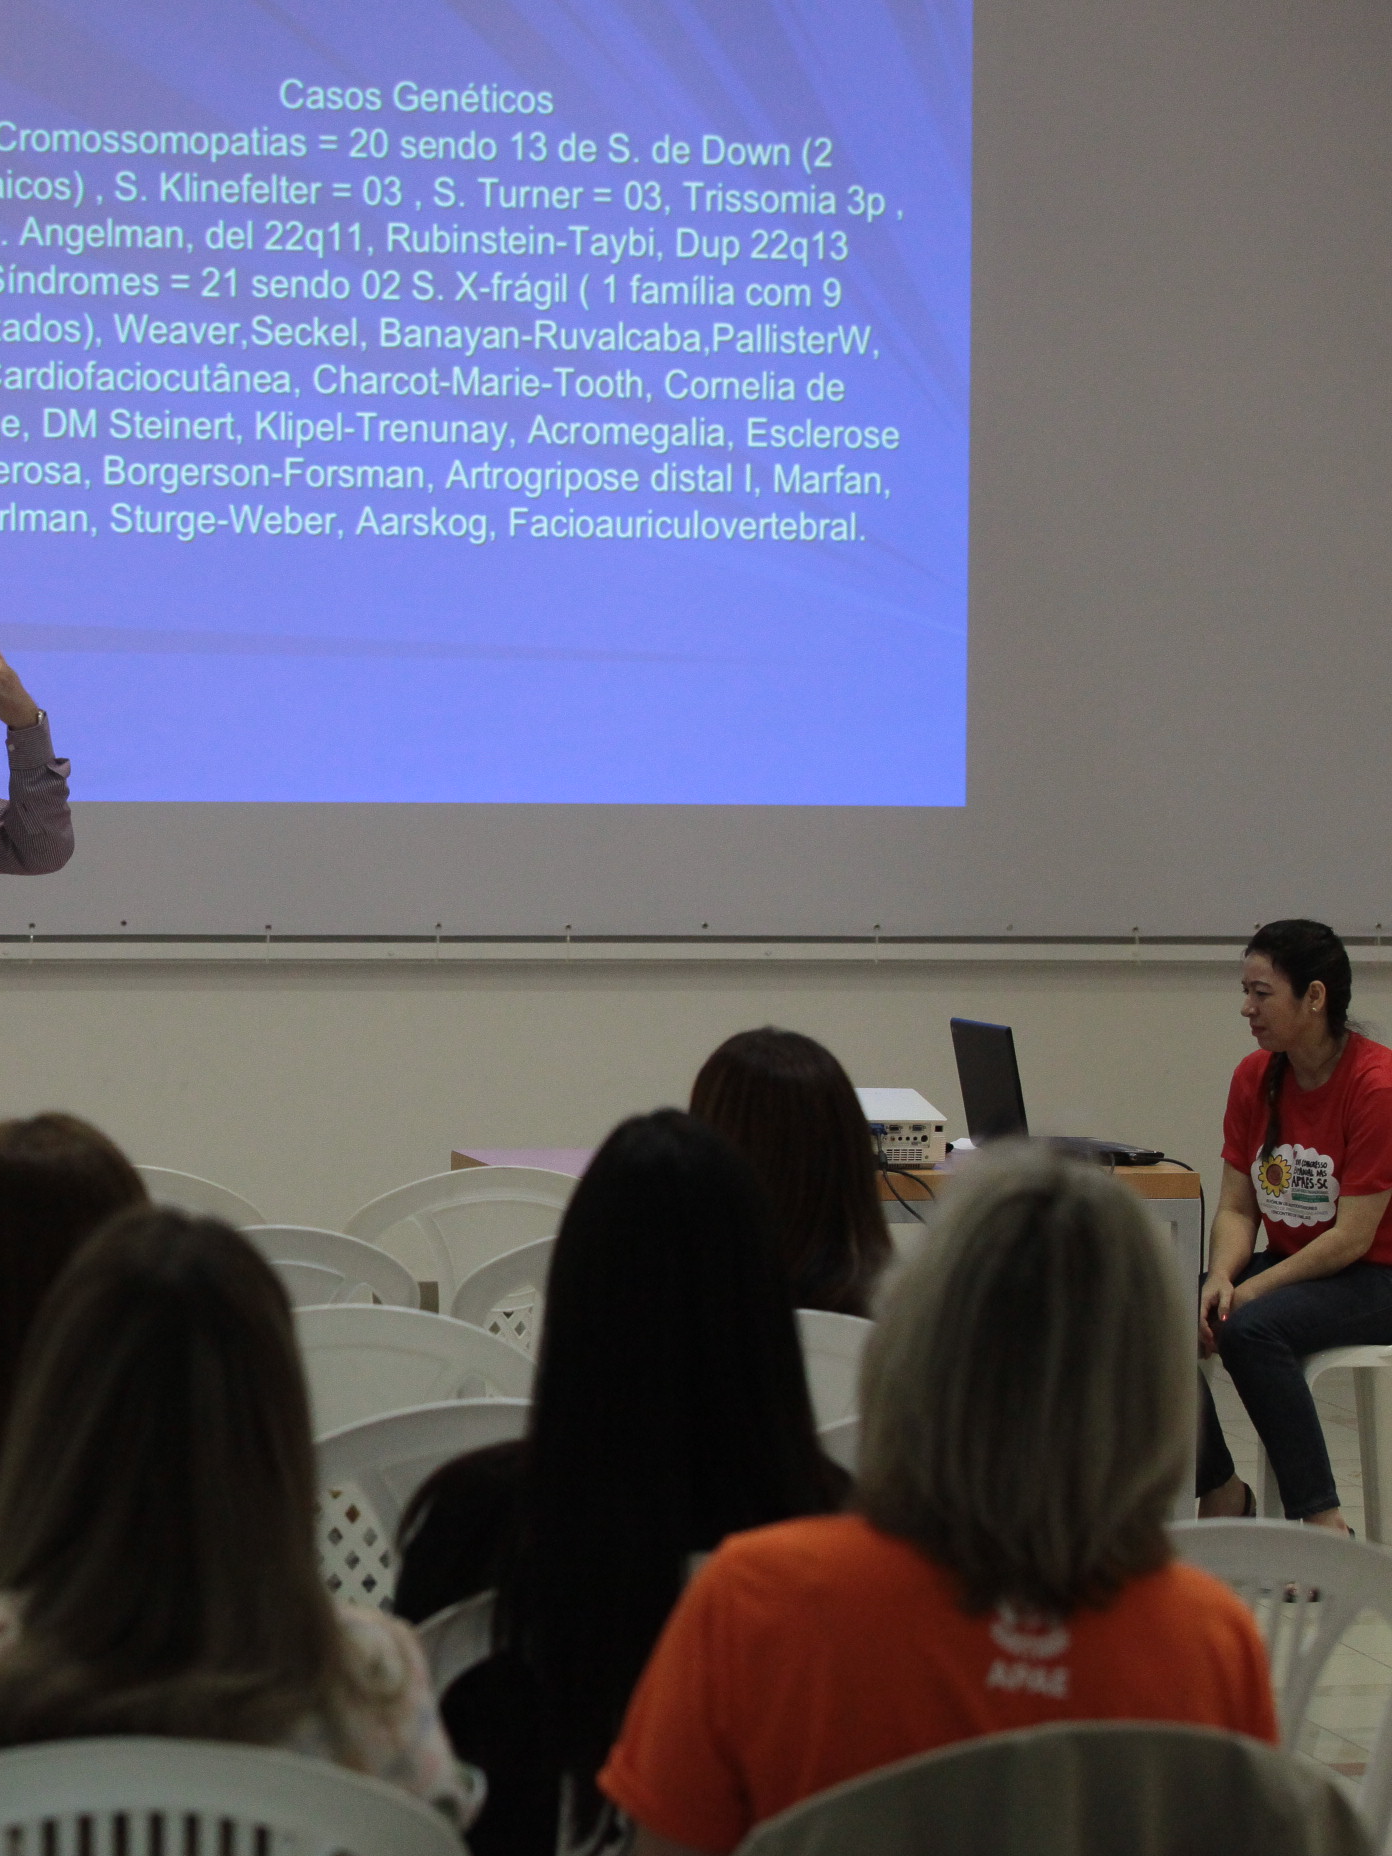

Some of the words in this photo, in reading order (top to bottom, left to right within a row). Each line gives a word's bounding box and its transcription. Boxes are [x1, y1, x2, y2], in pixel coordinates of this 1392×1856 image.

[280, 78, 382, 111] Casos
[393, 80, 554, 114] Genéticos
[319, 135, 338, 149] =
[349, 128, 389, 158] 20
[401, 130, 497, 160] sendo
[511, 131, 547, 161] 13
[558, 132, 597, 162] de
[608, 132, 639, 163] S.
[652, 134, 691, 164] de
[702, 134, 790, 166] Down
[802, 137, 832, 174] (2
[115, 170, 147, 201] S.
[161, 172, 322, 204] Klinefelter
[333, 183, 351, 197] =
[363, 176, 402, 206] 03
[434, 176, 465, 207] S.
[477, 177, 584, 209] Turner
[594, 188, 612, 202] =
[624, 180, 670, 214] 03,
[683, 181, 836, 214] Trissomia
[848, 185, 886, 222] 3p
[19, 216, 193, 255] Angelman,
[206, 220, 253, 250] del
[265, 220, 373, 258] 22q11,
[388, 222, 663, 264] Rubinstein-Taybi,
[676, 227, 740, 265] Dup
[751, 229, 848, 267] 22q13
[171, 274, 190, 288] =
[202, 267, 236, 297] 21
[252, 269, 350, 299] sendo
[362, 269, 401, 300] 02
[412, 270, 443, 300] S.
[455, 271, 567, 310] X-frágil
[604, 274, 615, 303] 1
[630, 274, 734, 305] família
[746, 284, 811, 306] com
[823, 277, 841, 307] 9
[314, 364, 651, 402] Charcot-Marie-Tooth,
[665, 369, 795, 400] Cornelia
[807, 372, 845, 401] de
[44, 408, 97, 438] DM
[110, 408, 242, 444] Steinert,
[256, 411, 515, 451] Klipel-Trenunay,
[528, 415, 733, 454] Acromegalia,
[747, 417, 900, 449] Esclerose
[104, 455, 433, 493] Borgerson-Forsman,
[445, 459, 639, 498] Artrogripose
[651, 462, 732, 492] distal
[745, 463, 760, 496] I,
[774, 463, 890, 499] Marfan,
[110, 502, 343, 541] Sturge-Weber,
[356, 506, 495, 544] Aarskog,
[510, 507, 865, 541] Facioauriculovertebral.
[986, 1658, 1069, 1698] APAE
